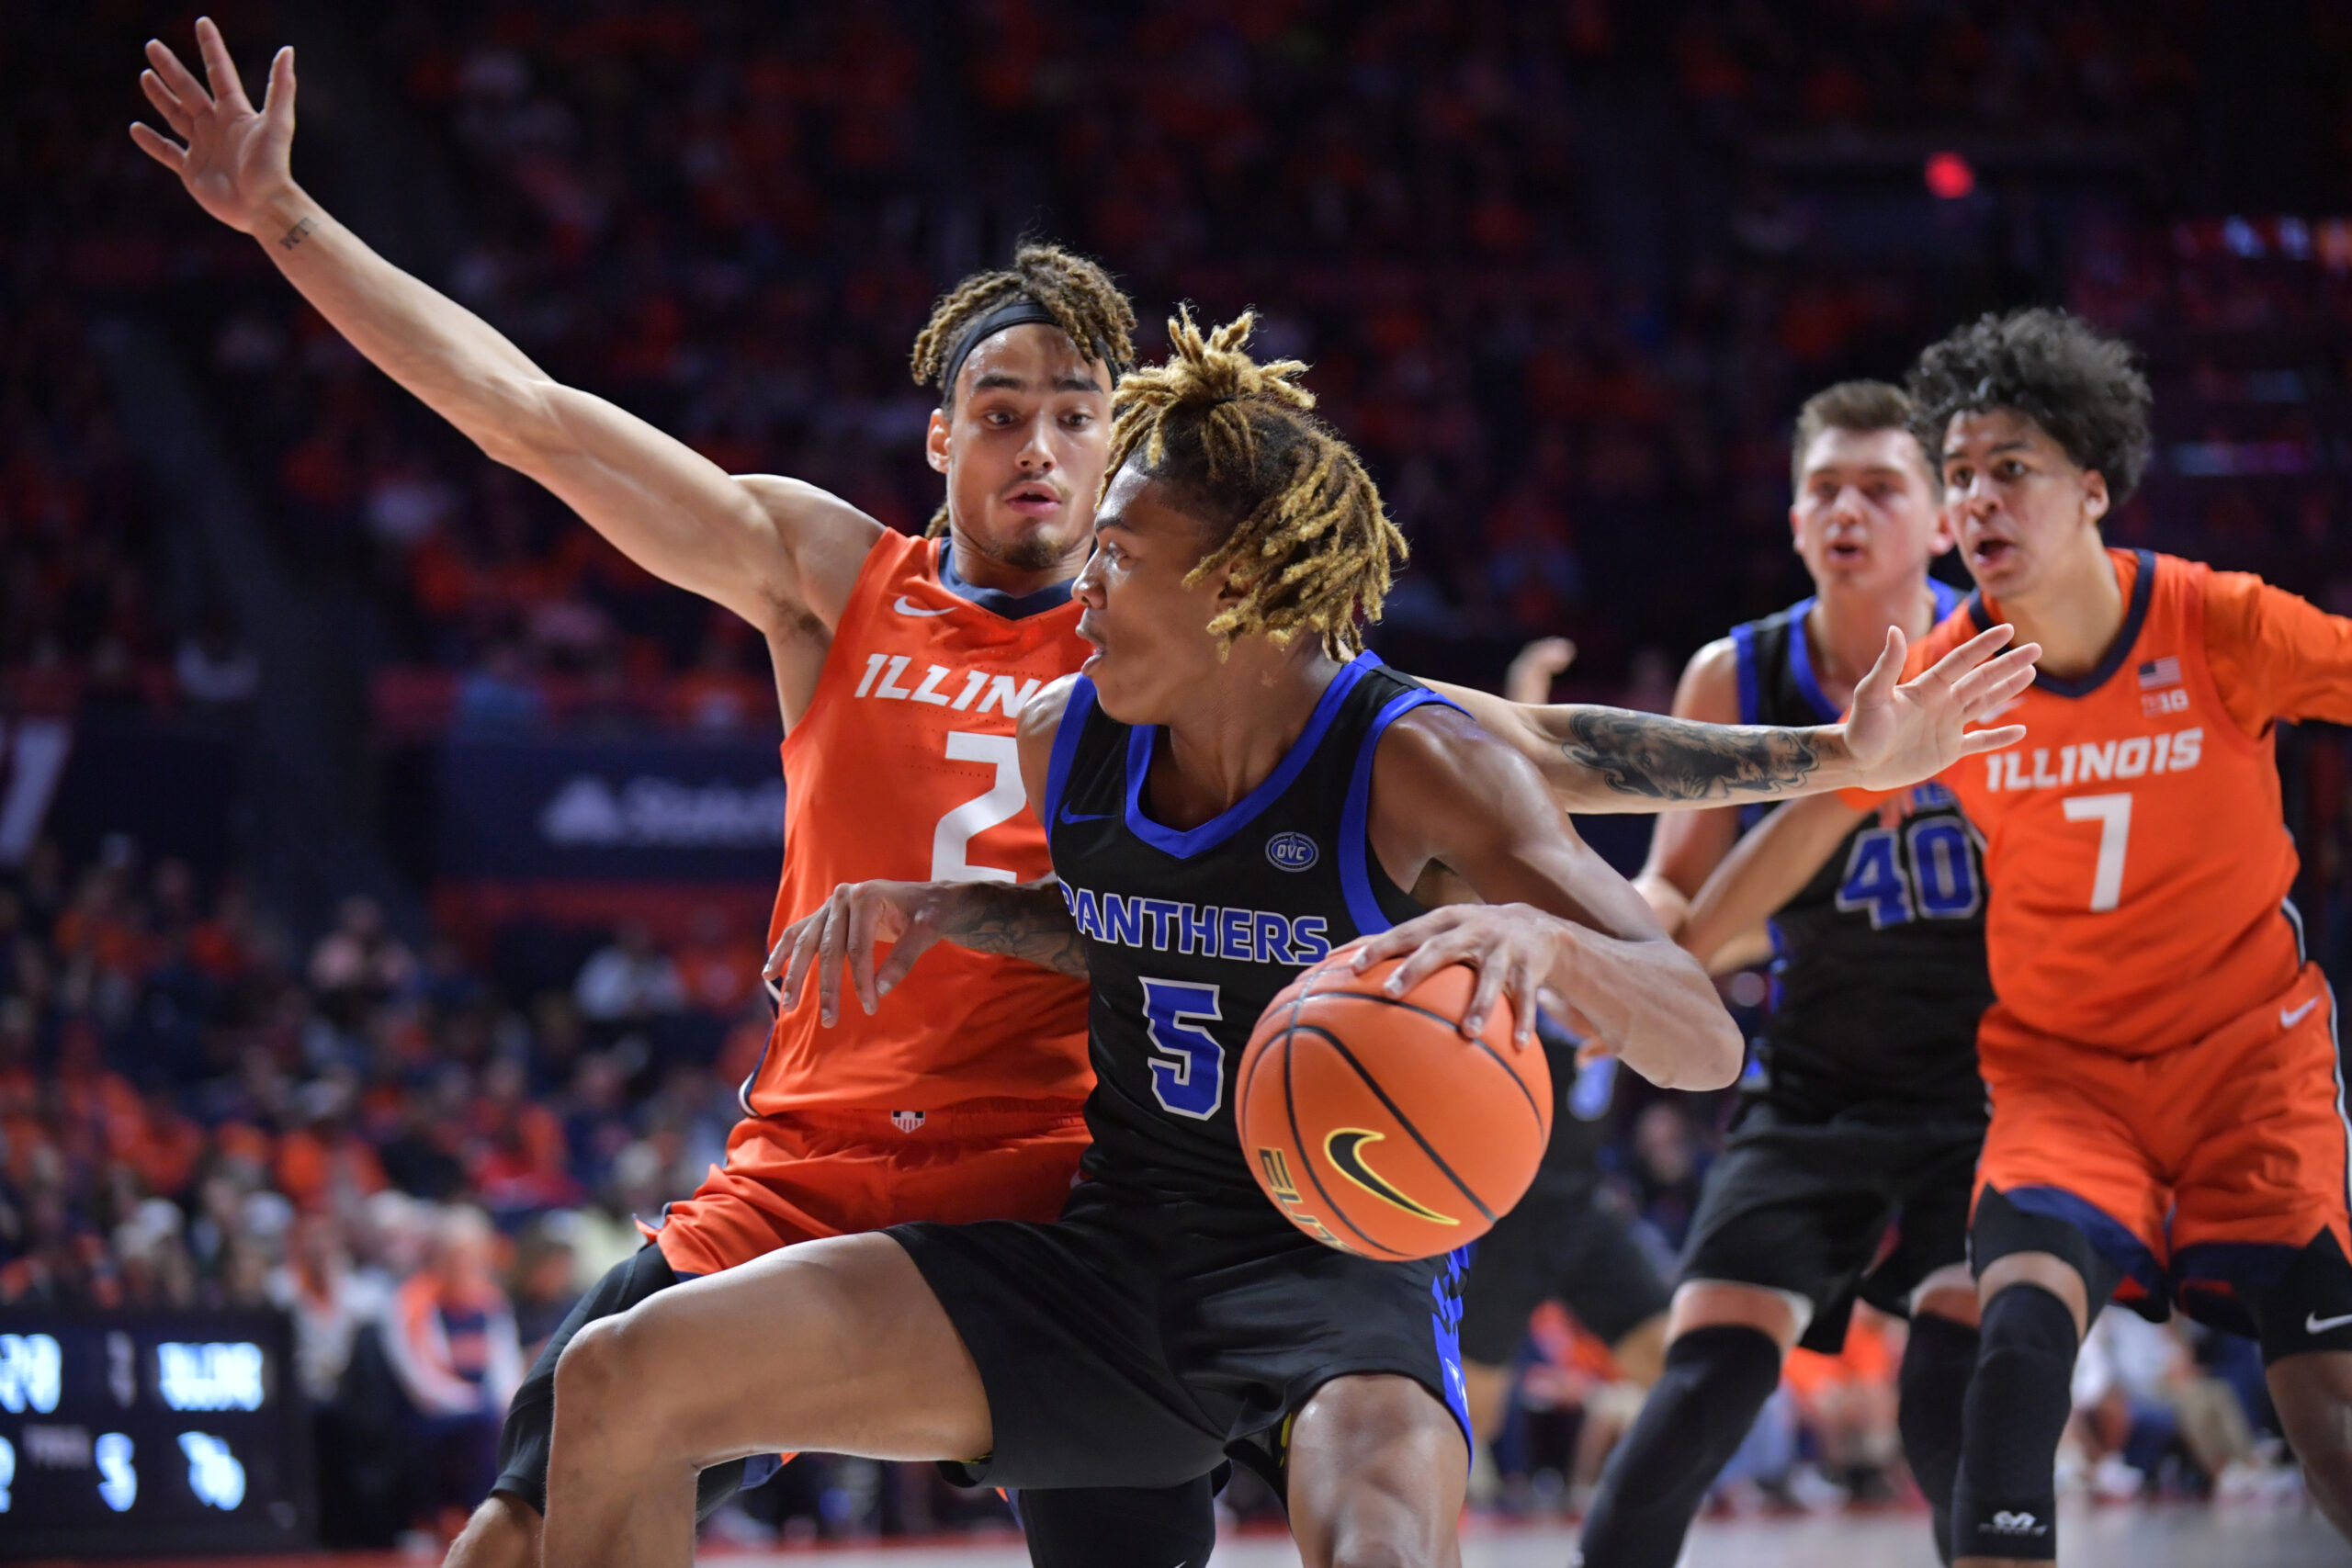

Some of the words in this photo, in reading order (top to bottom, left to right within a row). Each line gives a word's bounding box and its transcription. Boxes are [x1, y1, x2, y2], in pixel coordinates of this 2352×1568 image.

[931, 730, 1027, 884] 2
[1985, 728, 2203, 793] ILLINOIS
[1276, 844, 1306, 861] OVC
[1838, 818, 1983, 930] 40
[2064, 793, 2132, 913] 7
[1138, 976, 1225, 1121] 5
[1258, 1147, 1369, 1258] ELIT
